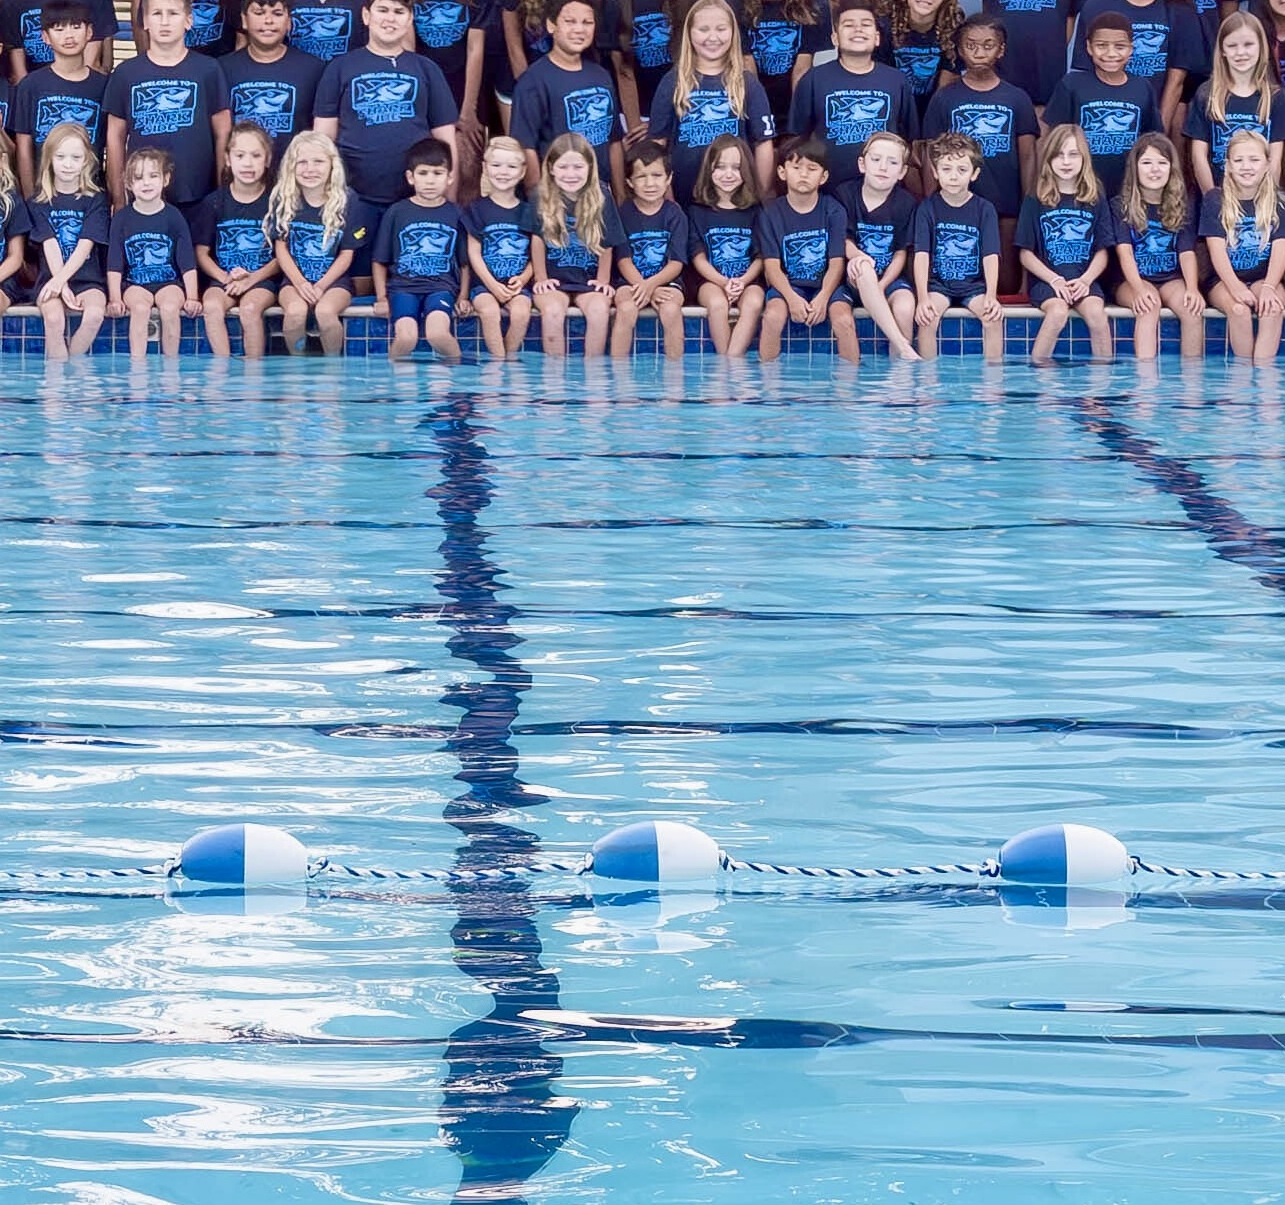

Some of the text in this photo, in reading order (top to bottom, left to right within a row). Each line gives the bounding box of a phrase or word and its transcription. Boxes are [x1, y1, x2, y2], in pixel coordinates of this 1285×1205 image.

[1007, 2, 1041, 11] SIDE
[296, 7, 331, 15] WELCOME
[1132, 23, 1165, 31] COME TO
[180, 79, 190, 87] TO
[240, 81, 275, 89] WELCOME
[47, 96, 82, 104] WELCOME
[959, 104, 996, 112] WELCOME
[1089, 100, 1136, 109] WELCOME TO
[135, 109, 192, 128] SHARK
[140, 124, 178, 136] SIDE
[827, 121, 884, 139] SHARK
[1047, 209, 1093, 218] WELCOME TO
[708, 227, 741, 235] WELCOME
